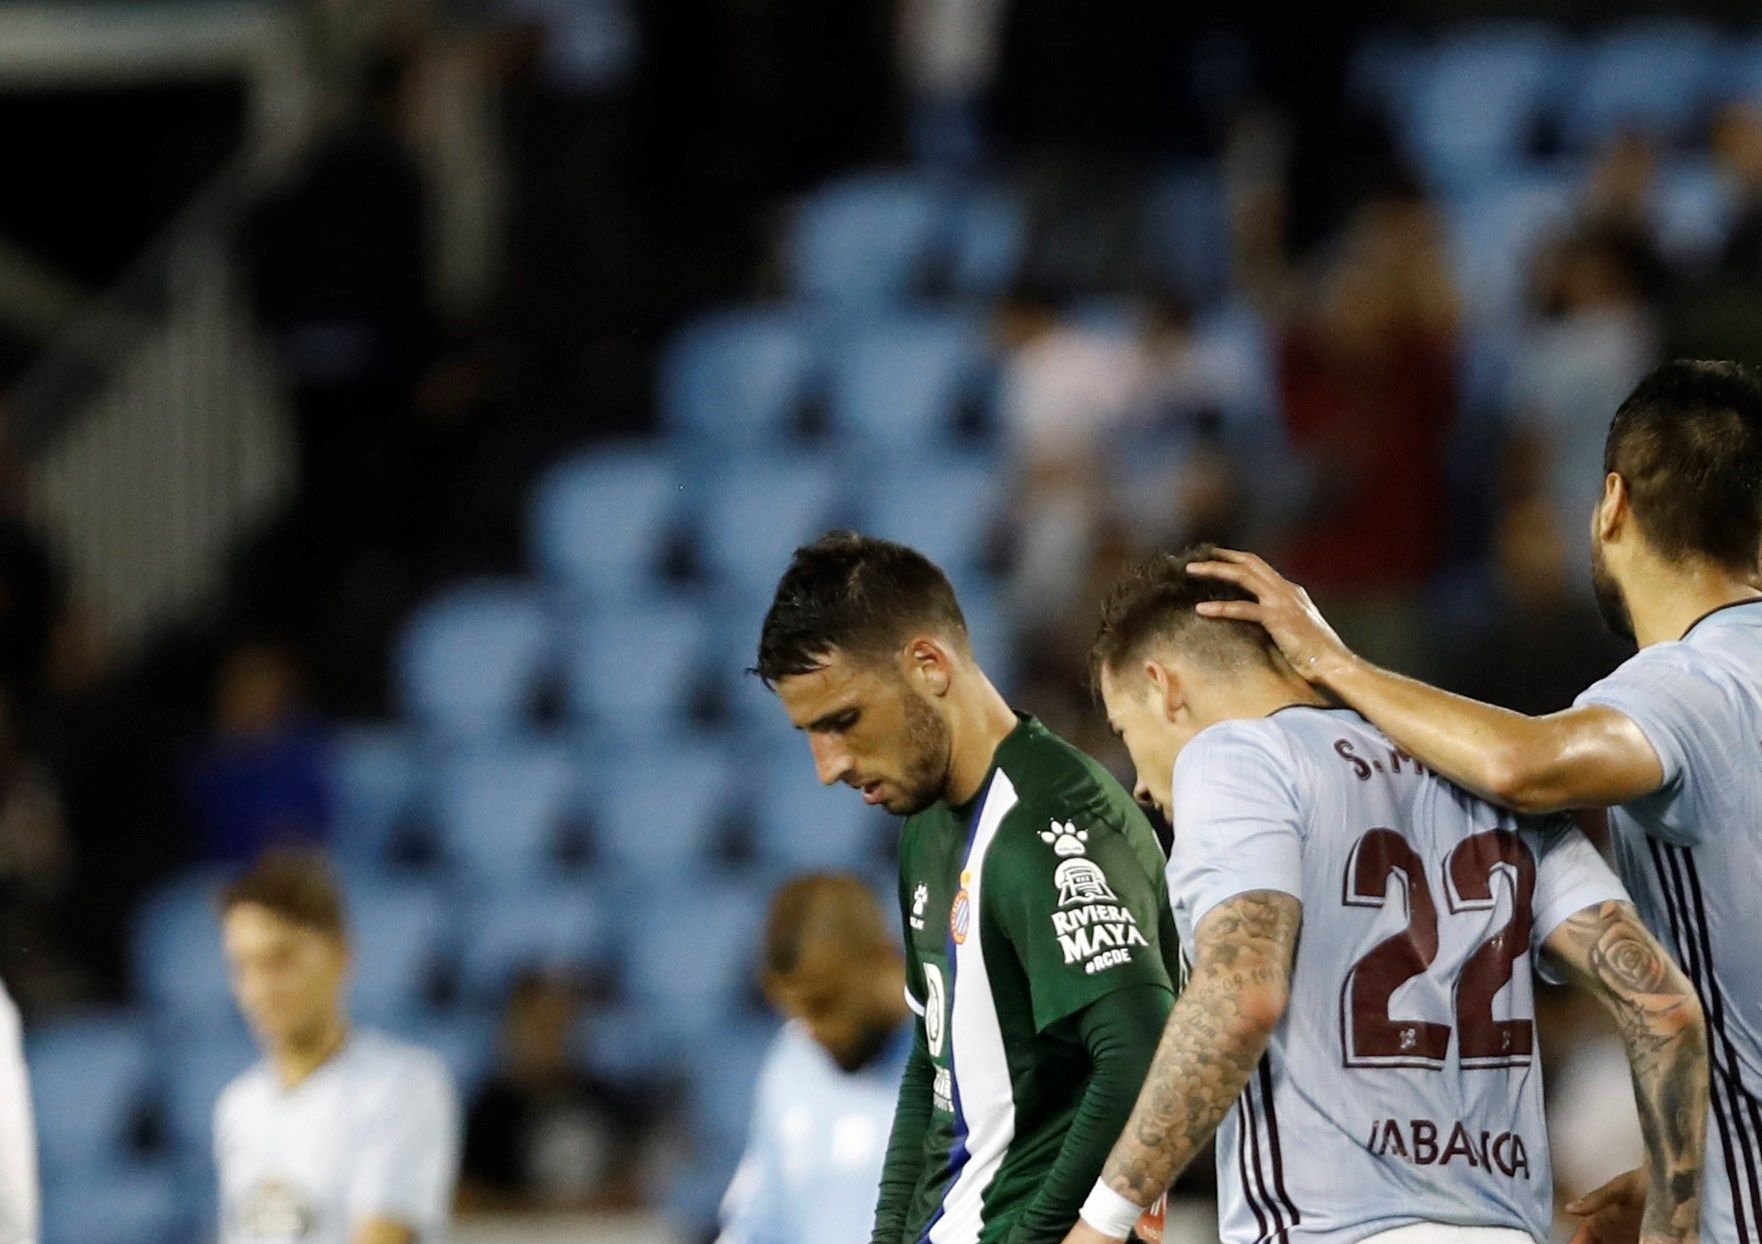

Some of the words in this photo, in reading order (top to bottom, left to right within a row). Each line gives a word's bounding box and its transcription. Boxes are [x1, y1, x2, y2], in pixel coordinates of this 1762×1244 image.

[1051, 904, 1136, 936] RIVIERA
[1057, 923, 1149, 965] MAYA
[1341, 826, 1536, 1070] 22
